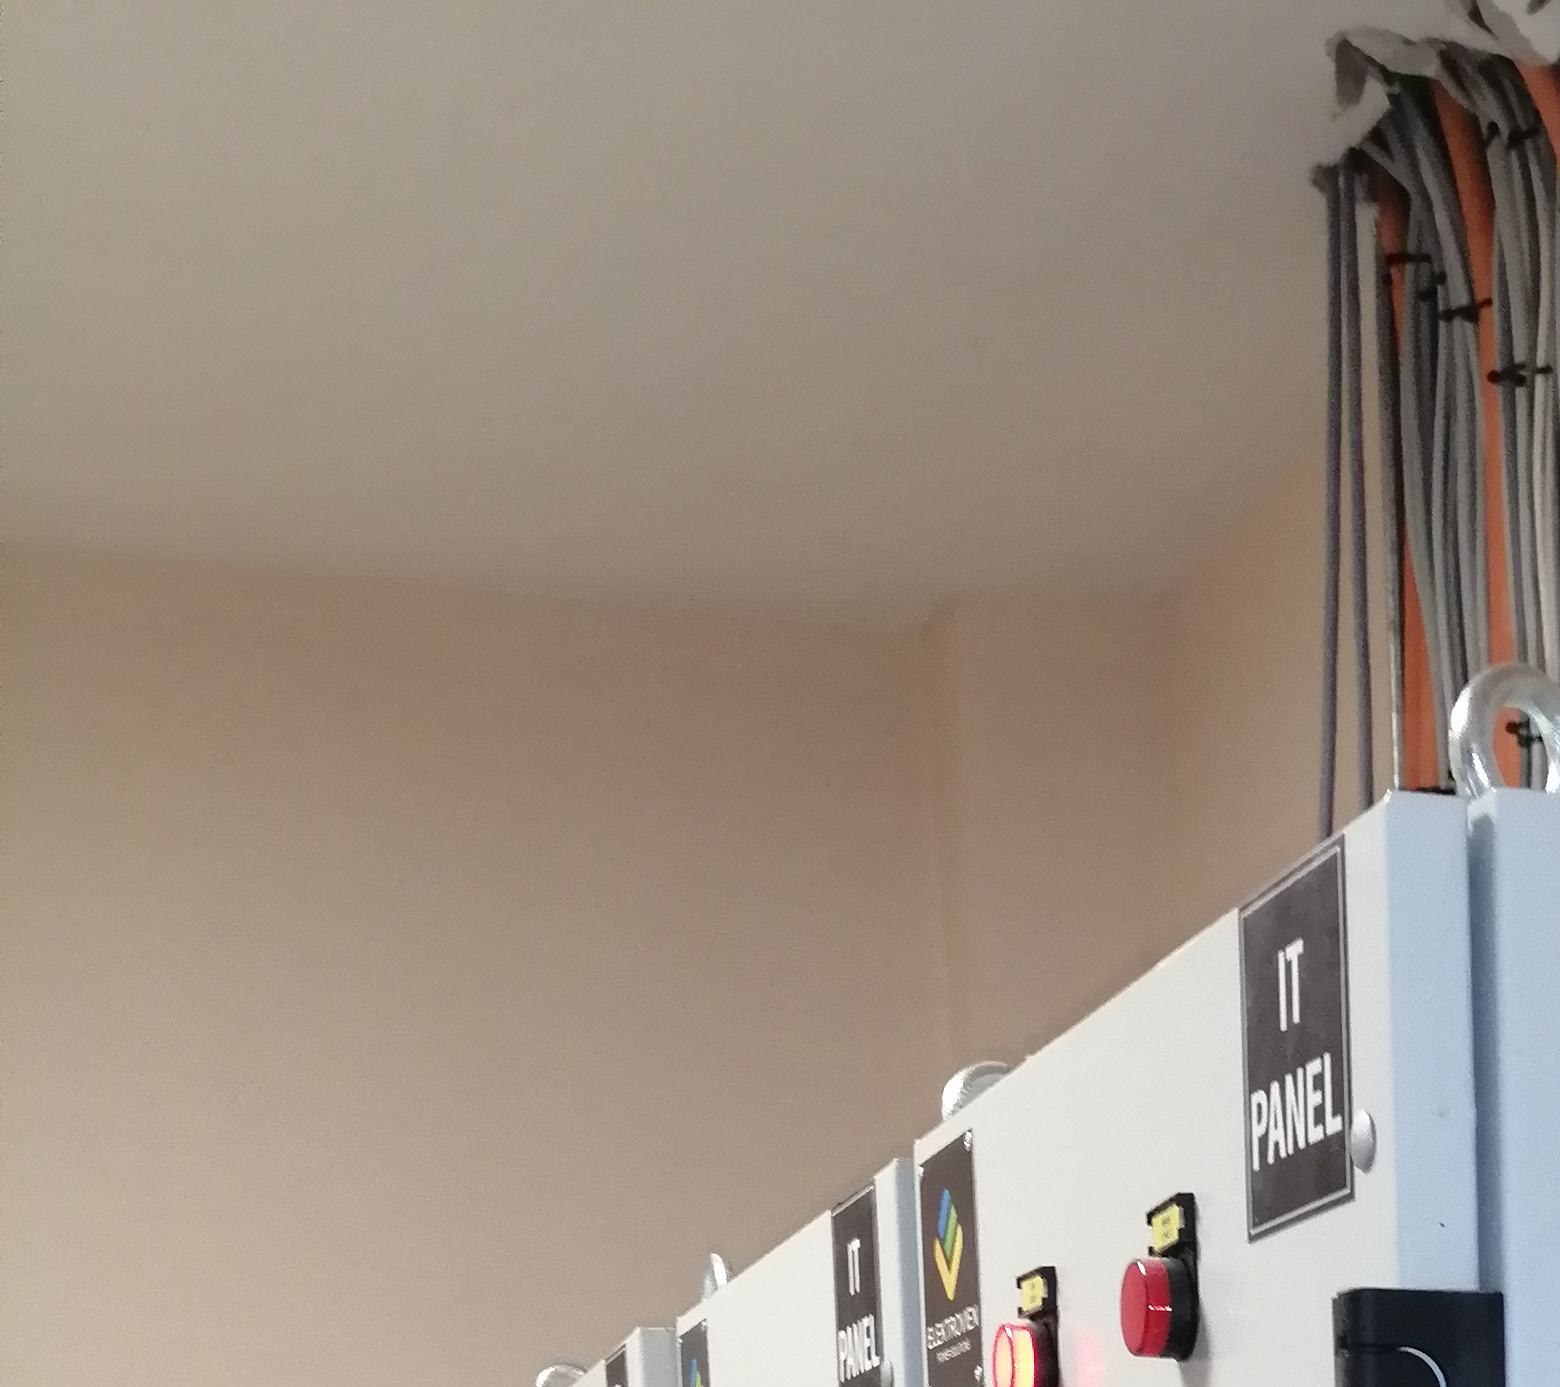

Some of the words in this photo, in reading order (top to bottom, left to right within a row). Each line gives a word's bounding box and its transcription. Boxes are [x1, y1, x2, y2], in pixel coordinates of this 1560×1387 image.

[1277, 938, 1304, 1032] IT
[1250, 1051, 1343, 1173] PANEL
[846, 1237, 861, 1296] IT
[838, 1313, 880, 1383] PANEL
